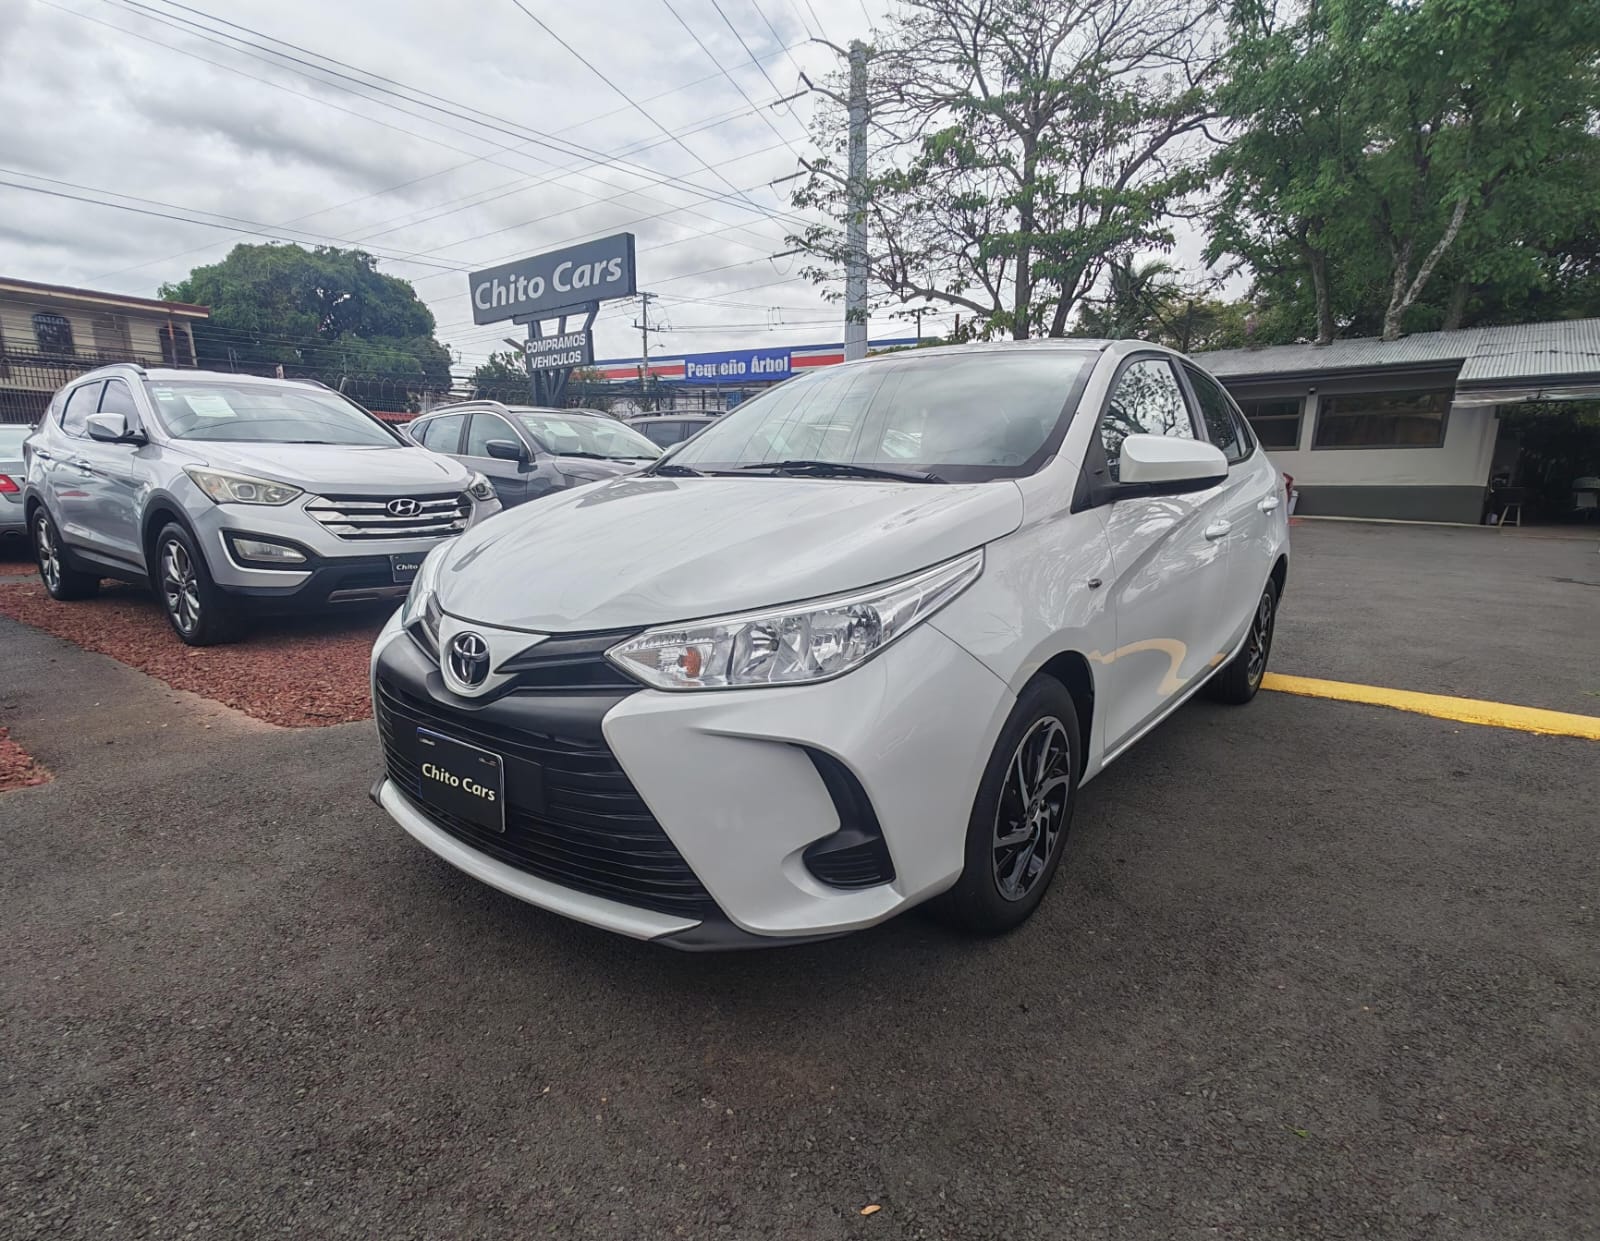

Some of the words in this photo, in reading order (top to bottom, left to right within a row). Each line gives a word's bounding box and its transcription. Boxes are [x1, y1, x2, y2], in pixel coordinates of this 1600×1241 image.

[474, 274, 545, 310] Chito
[552, 257, 622, 292] Cars
[526, 333, 586, 354] COMPRAMOS
[531, 350, 582, 369] VEHICULOS
[751, 355, 789, 374] Árbol
[396, 563, 418, 571] Chito
[421, 763, 459, 787] Chito
[462, 778, 496, 801] Cars
